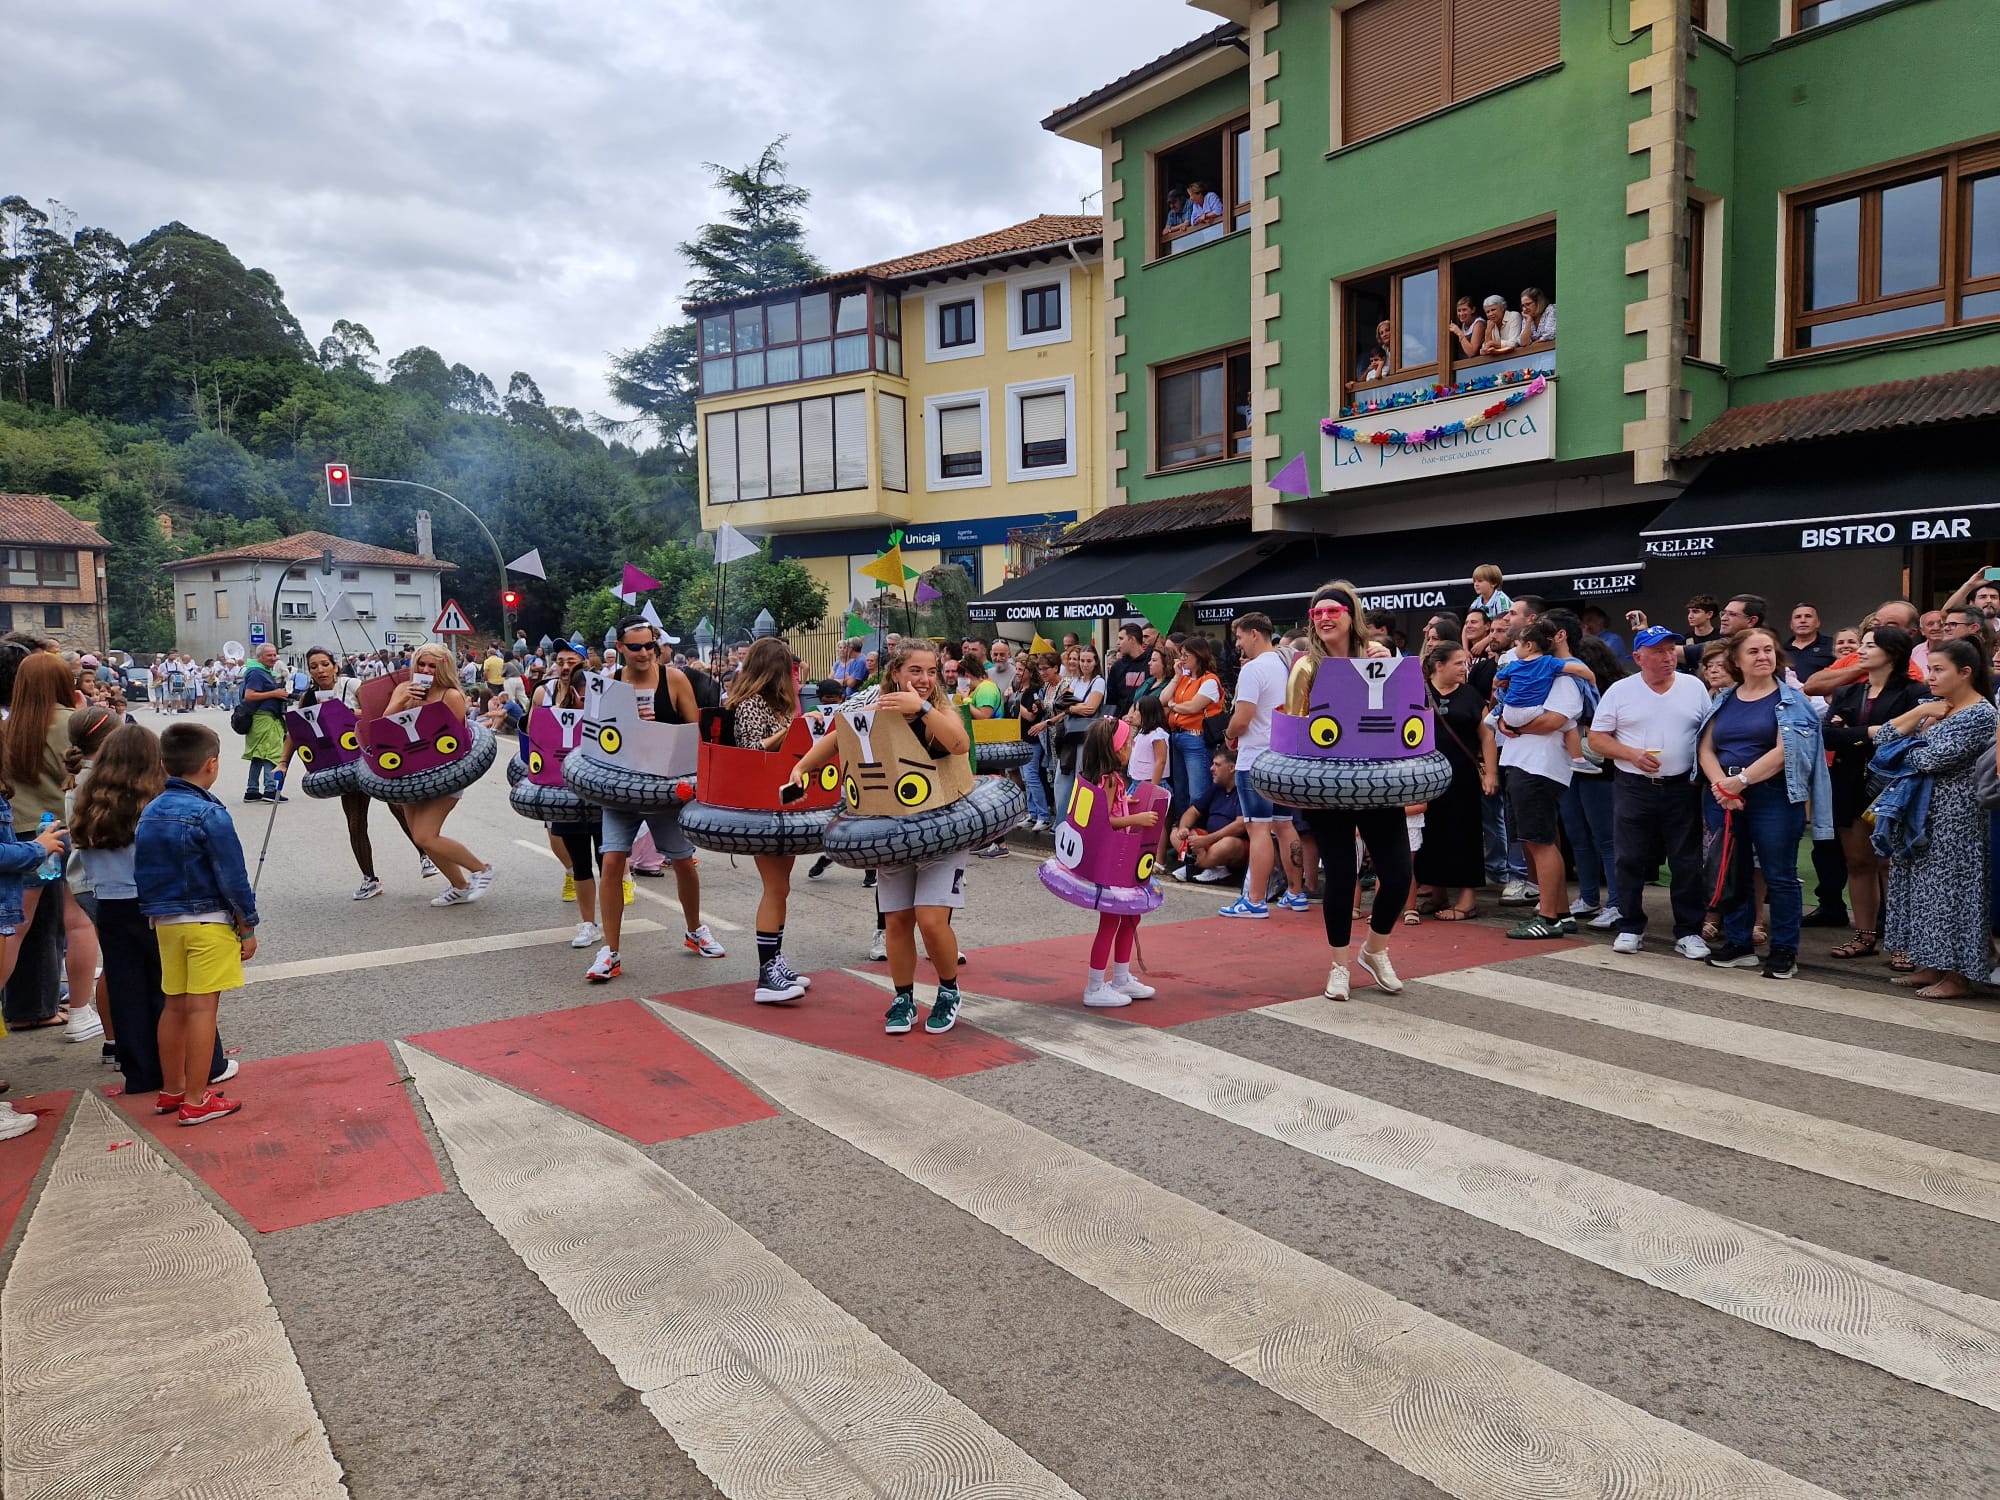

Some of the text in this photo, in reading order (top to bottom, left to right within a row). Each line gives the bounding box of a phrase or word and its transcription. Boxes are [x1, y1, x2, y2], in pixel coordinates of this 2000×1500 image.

[905, 532, 941, 545] Unicaja
[1802, 518, 1971, 549] BISTRO BAR
[1645, 537, 1715, 552] KELER
[1572, 574, 1637, 590] KELER
[1358, 591, 1447, 611] ARIENTUCA
[969, 608, 997, 618] KELER
[1006, 607, 1042, 620] COCINA
[1045, 606, 1060, 618] DE
[1063, 603, 1115, 617] MERCADO
[1198, 607, 1234, 619] KELER
[1366, 662, 1386, 679] 12
[398, 714, 413, 725] 31
[561, 711, 575, 726] 09
